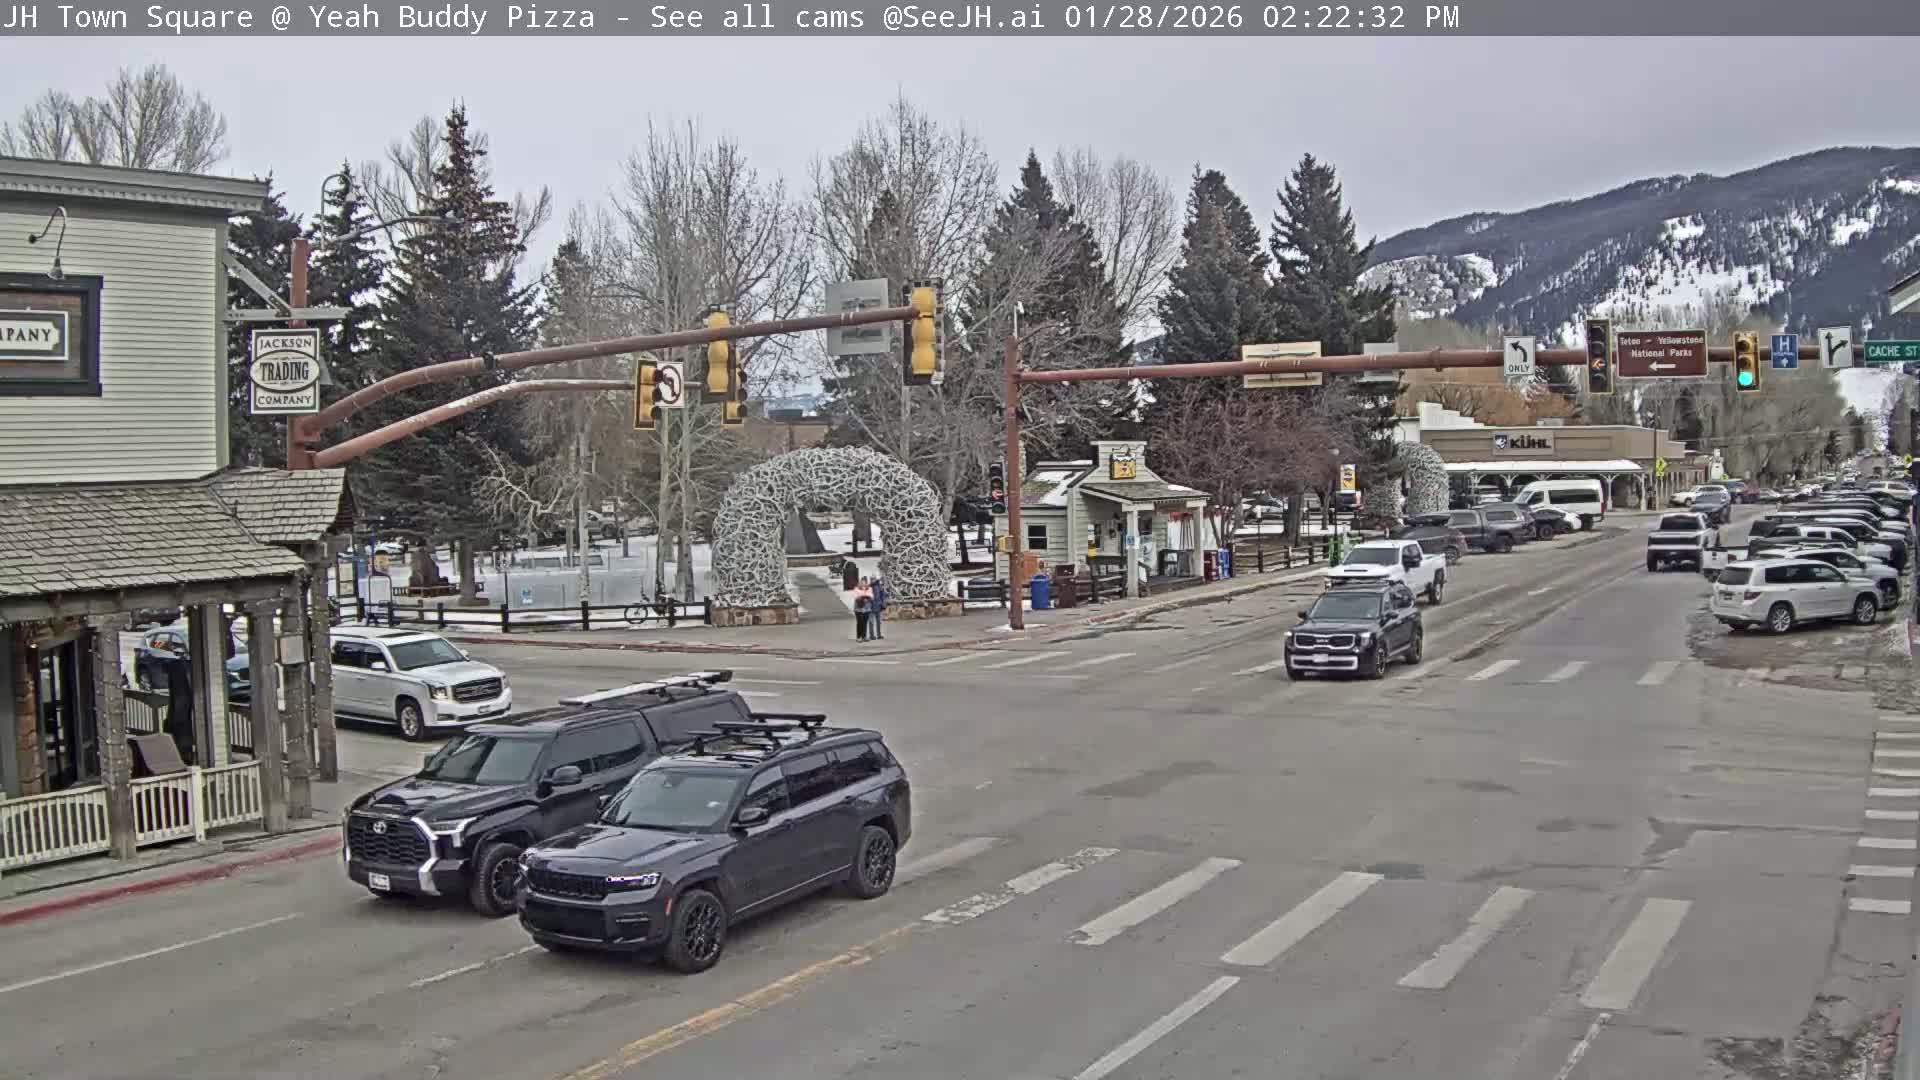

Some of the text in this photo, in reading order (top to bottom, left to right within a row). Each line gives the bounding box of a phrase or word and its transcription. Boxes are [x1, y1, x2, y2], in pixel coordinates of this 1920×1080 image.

[0, 328, 51, 341] PANY
[260, 338, 312, 349] JACKSON
[1657, 336, 1705, 345] Yellowstone
[1779, 335, 1790, 352] H
[1631, 348, 1693, 358] National Parks
[1868, 345, 1919, 357] CACHE ST
[260, 361, 309, 381] TRADING
[1508, 364, 1531, 373] ONLY
[257, 395, 312, 405] COMPANY
[1510, 434, 1552, 449] KÜHL
